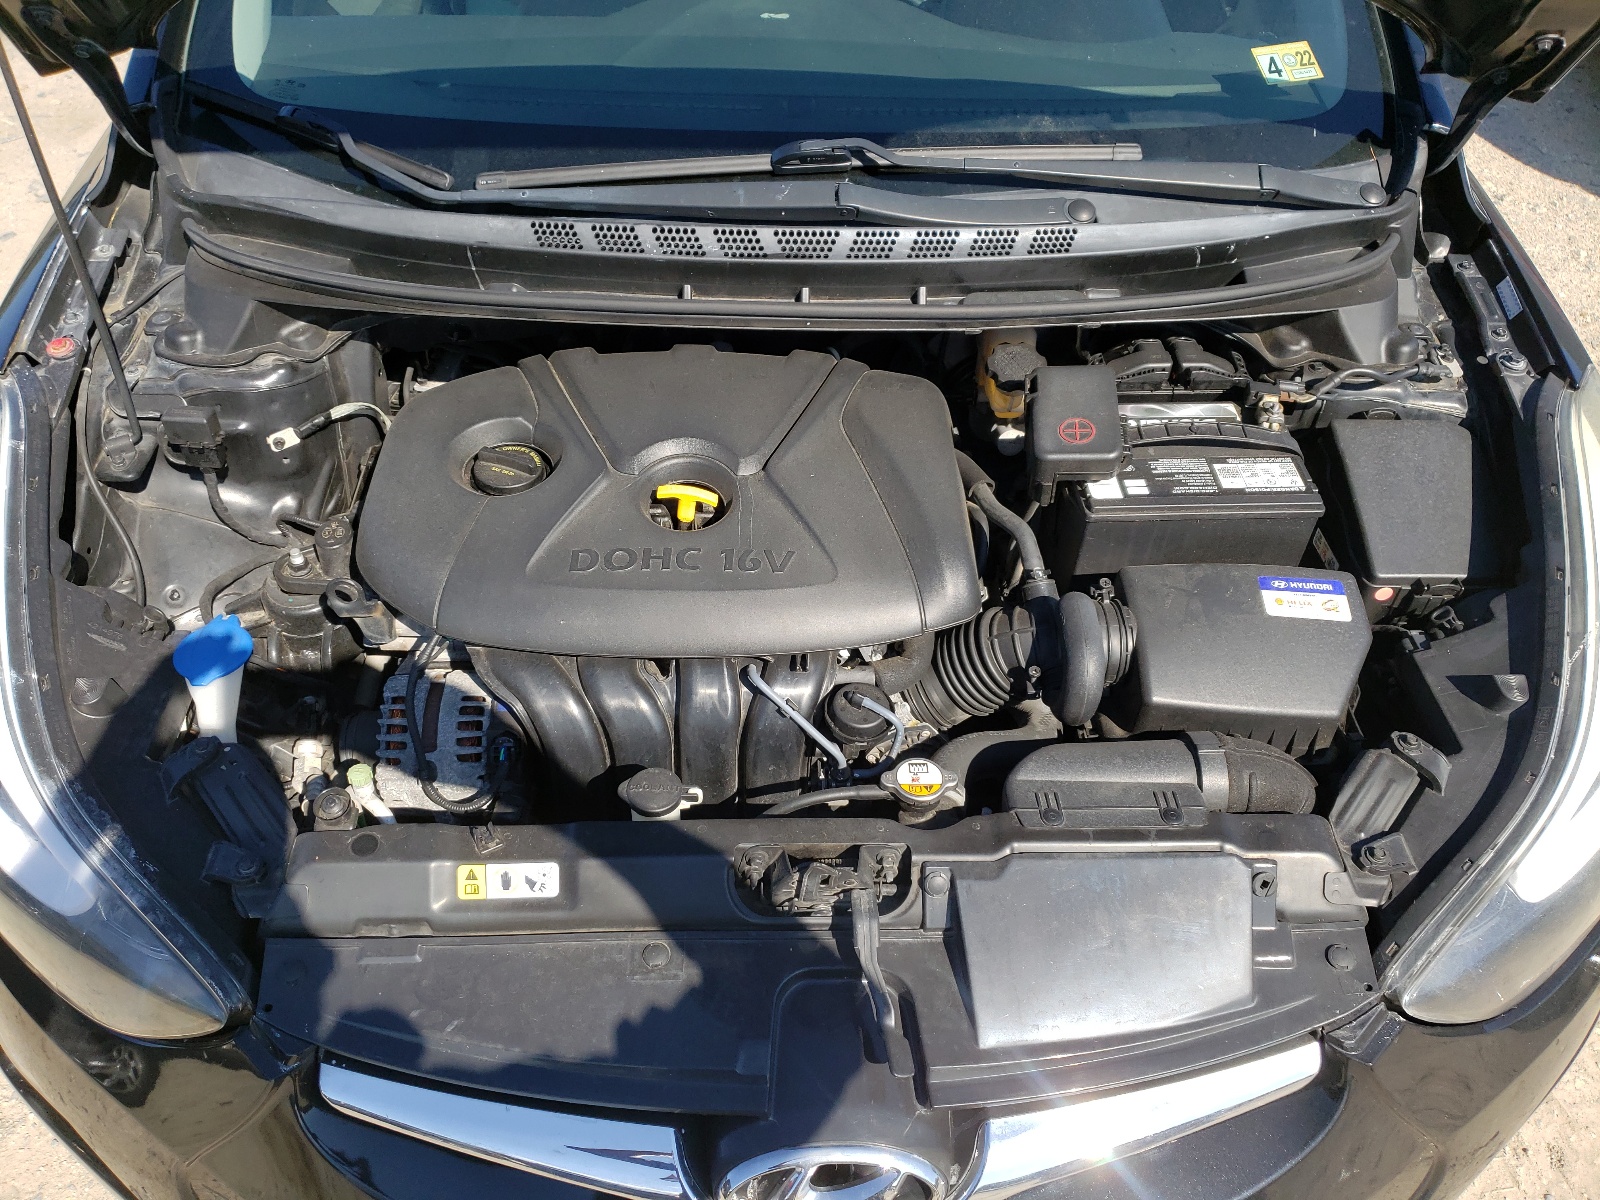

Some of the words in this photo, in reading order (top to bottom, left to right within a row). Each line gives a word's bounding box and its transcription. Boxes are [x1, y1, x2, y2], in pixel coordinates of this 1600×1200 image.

[1268, 56, 1283, 78] 4
[1295, 50, 1315, 67] 22
[569, 547, 702, 573] DOHC
[720, 548, 797, 574] 16V
[1290, 581, 1333, 591] HYUNDAI
[628, 783, 682, 792] COOLANT
